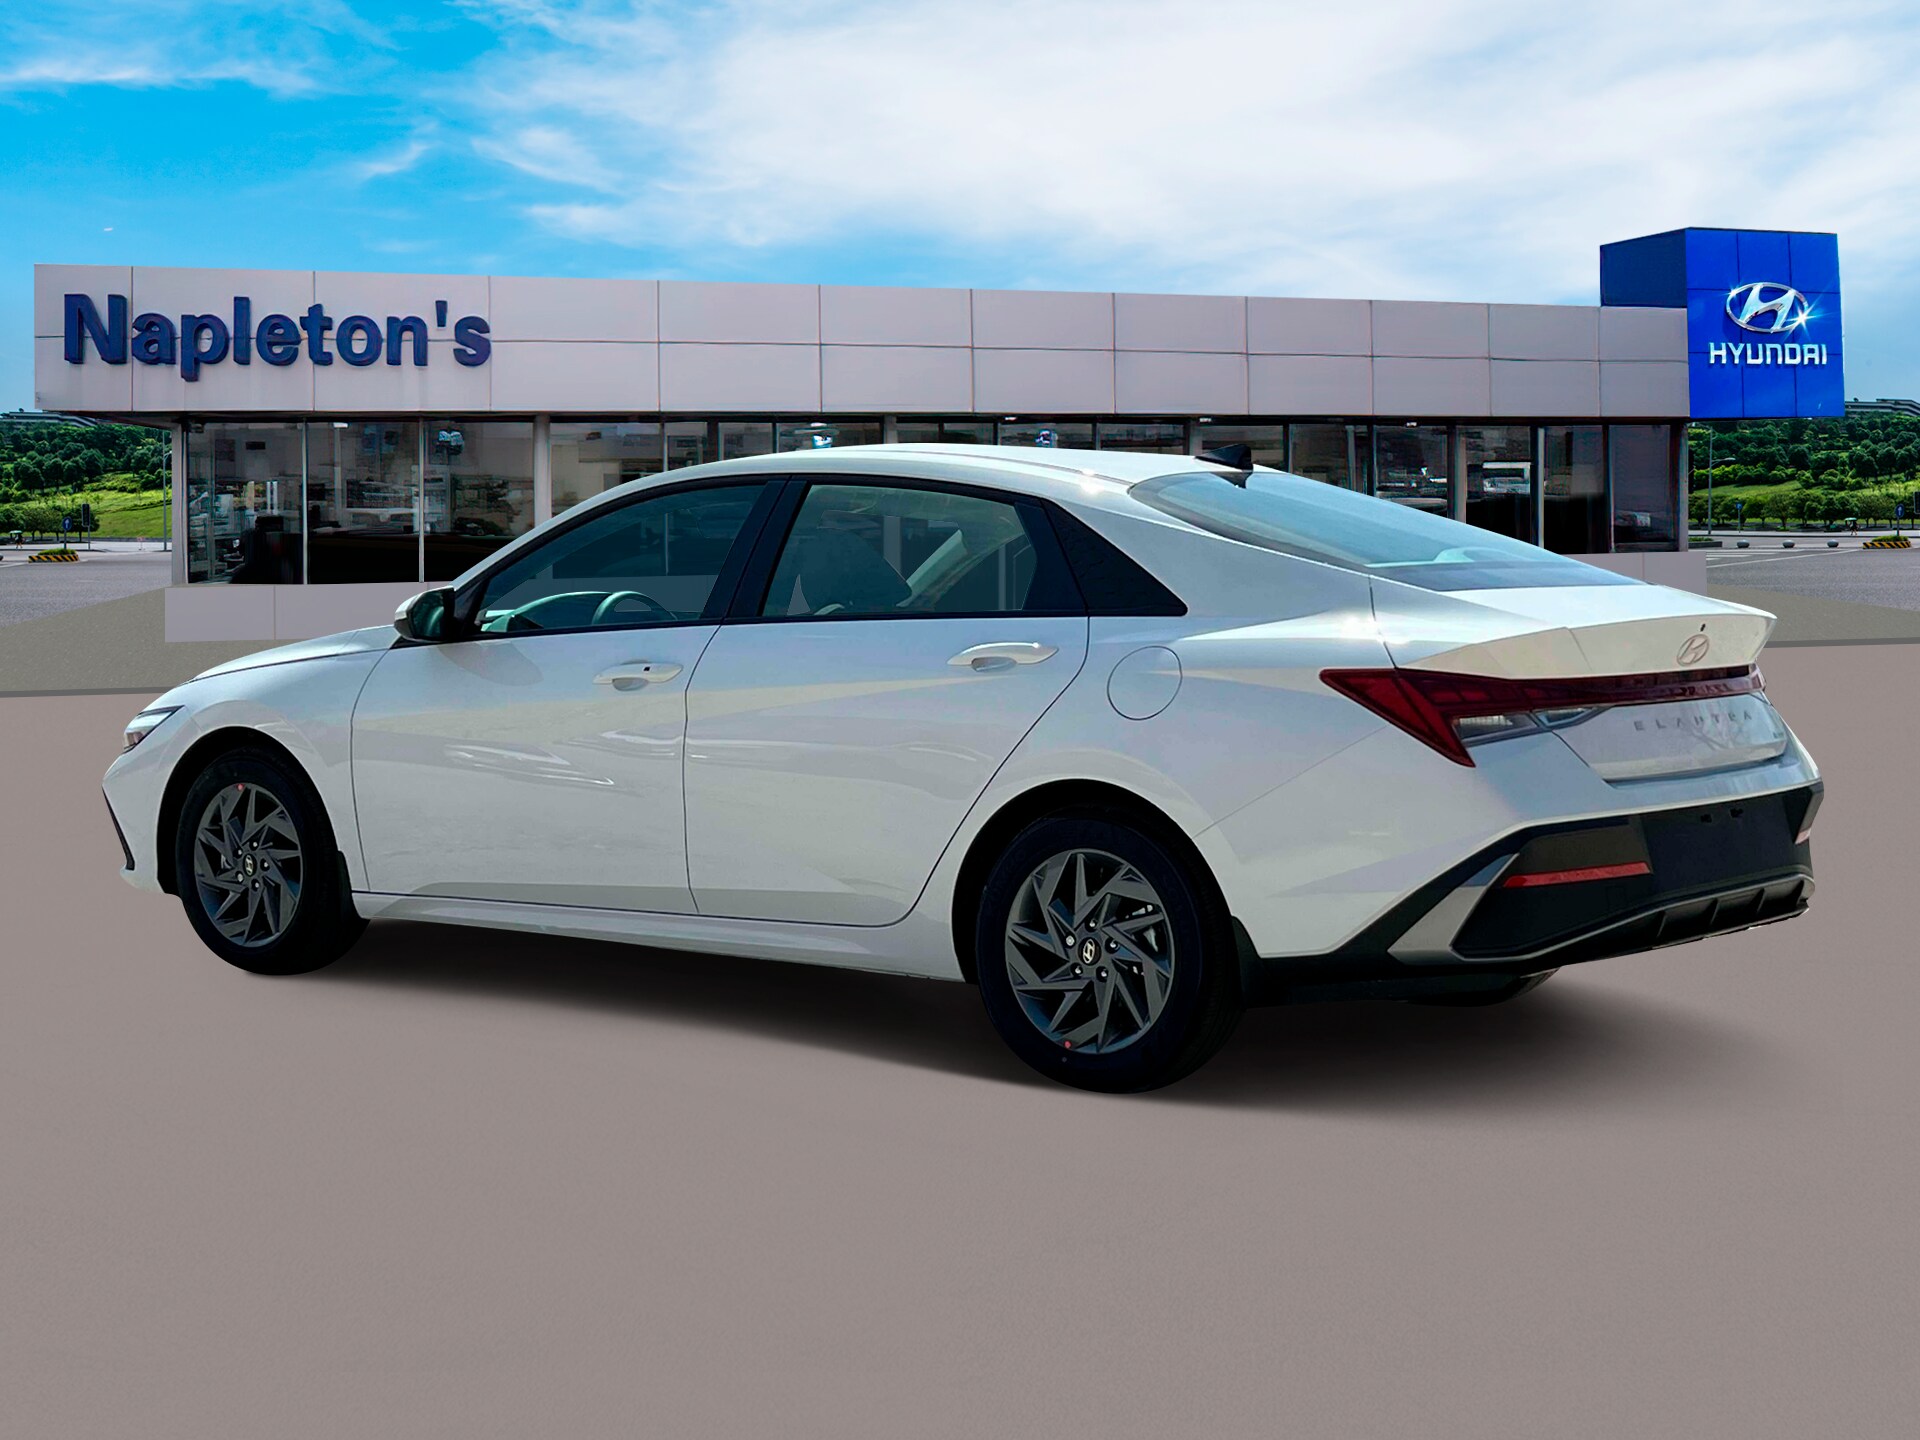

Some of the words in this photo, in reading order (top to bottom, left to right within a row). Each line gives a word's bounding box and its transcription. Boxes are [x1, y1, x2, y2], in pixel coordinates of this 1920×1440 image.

[64, 293, 491, 382] Napleton's
[1709, 342, 1828, 365] HYUNDAI
[1634, 710, 1752, 731] ELANTRA
